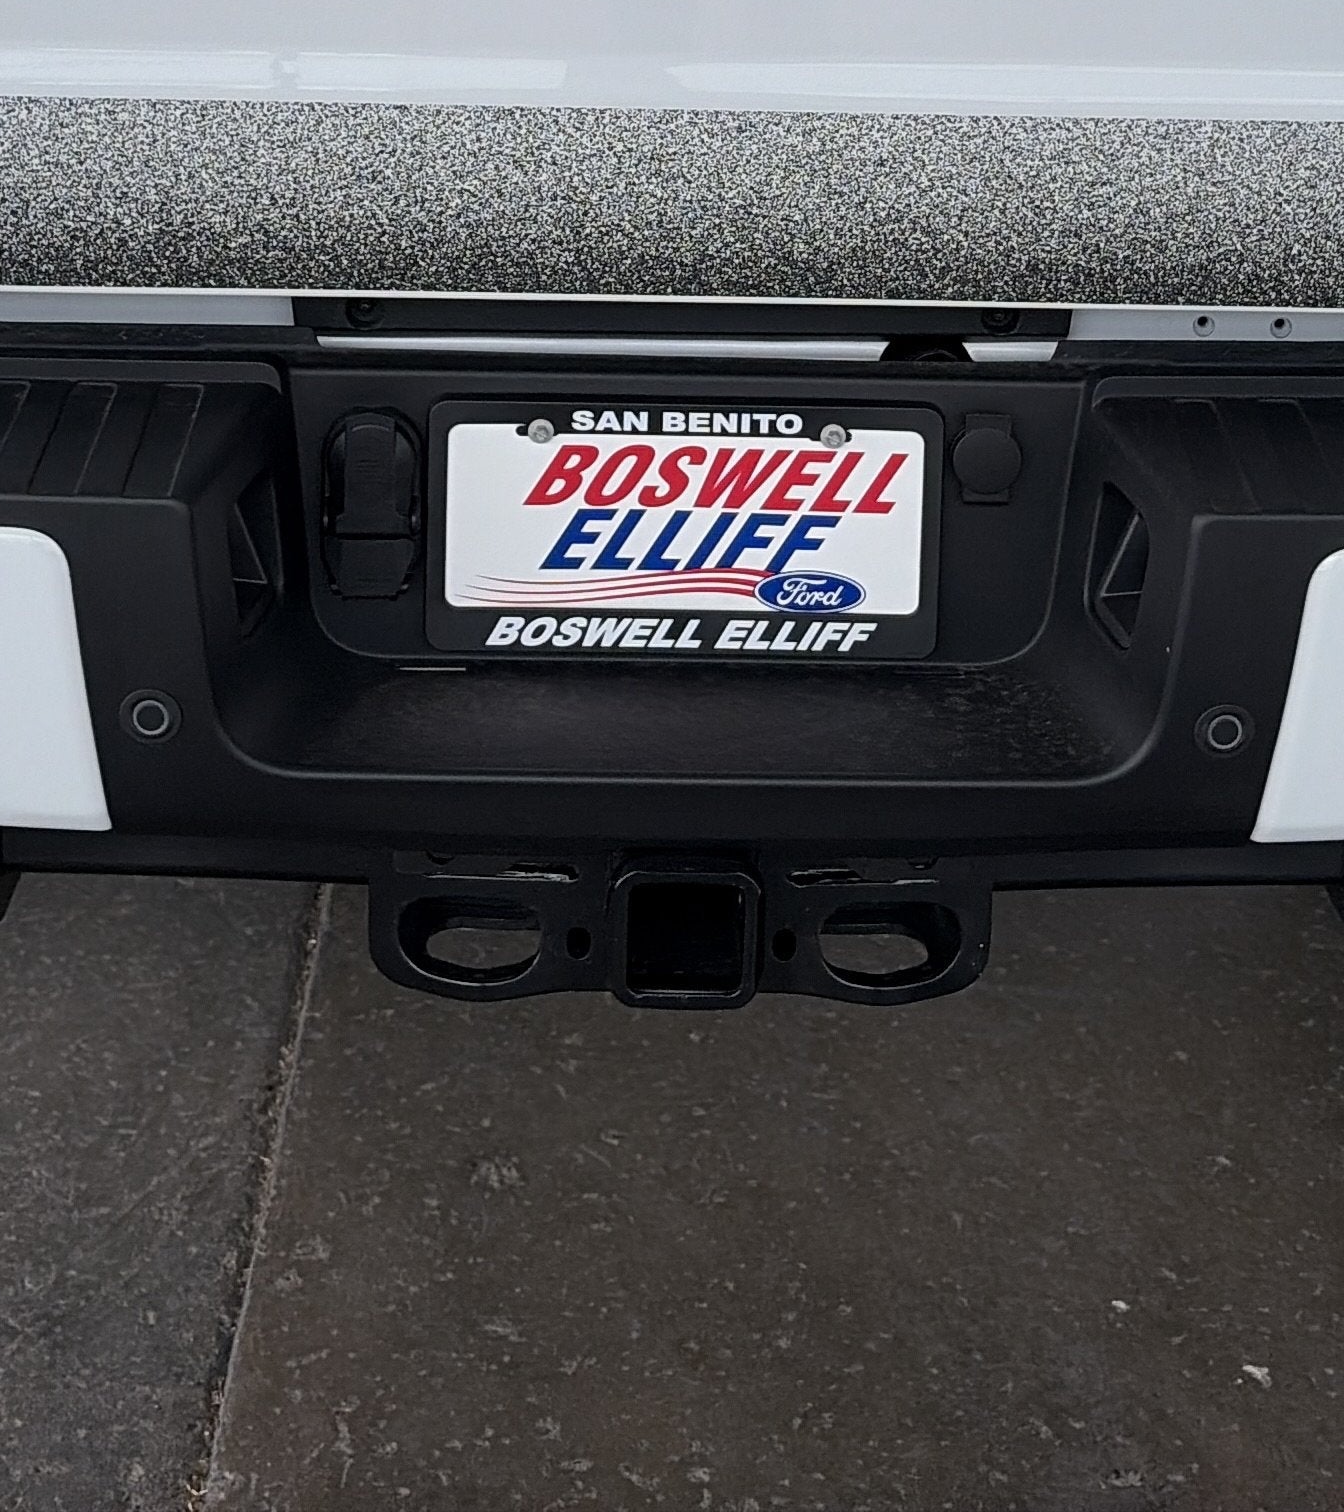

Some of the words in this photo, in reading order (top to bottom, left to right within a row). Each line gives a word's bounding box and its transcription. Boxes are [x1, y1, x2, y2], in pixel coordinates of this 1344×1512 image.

[571, 410, 649, 432] SAN
[661, 411, 804, 435] BENITO
[523, 444, 909, 514] BOSWELL
[538, 508, 843, 572] ELLIFF
[775, 579, 844, 607] Ford
[484, 616, 703, 648] BOSWELL
[713, 619, 877, 652] ELLIFF
